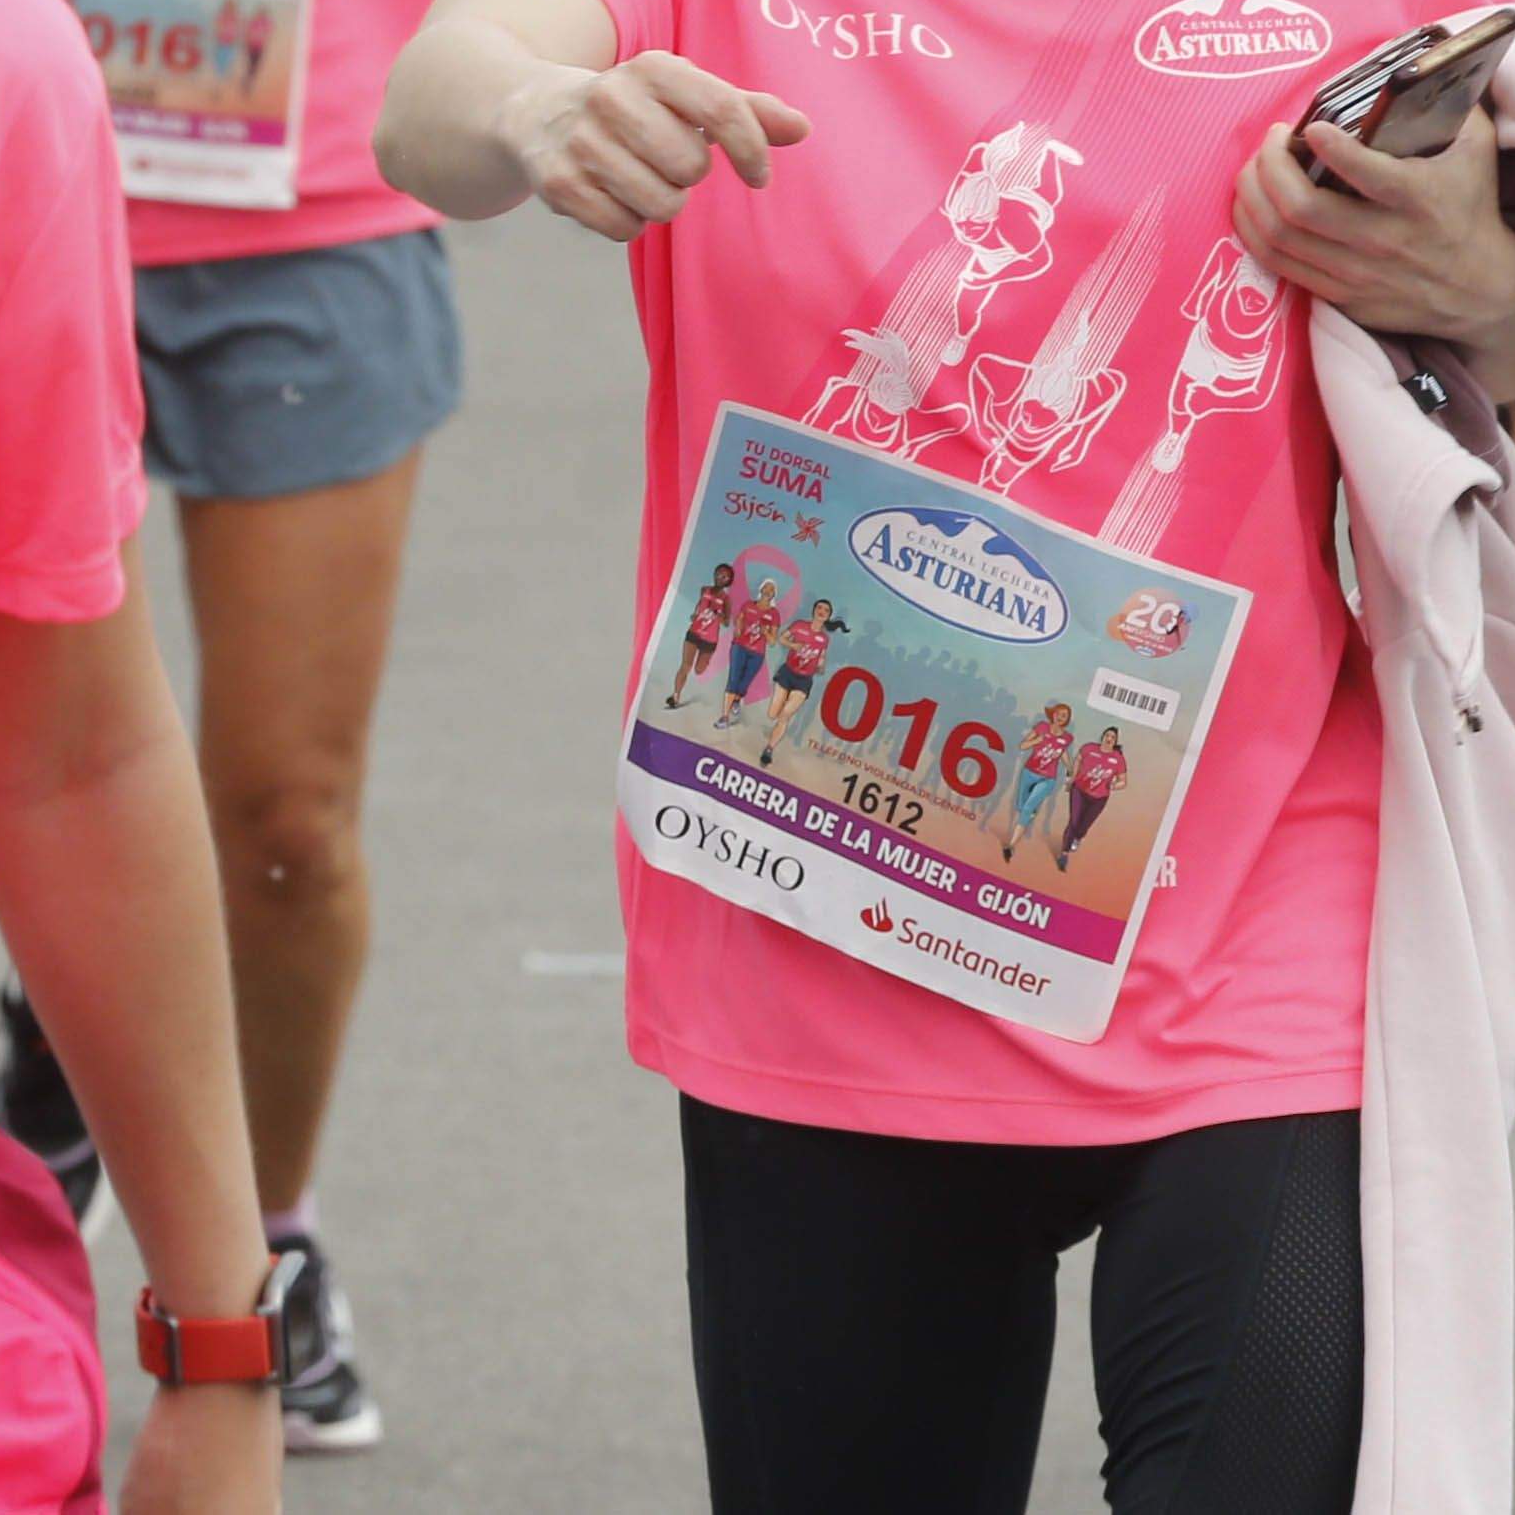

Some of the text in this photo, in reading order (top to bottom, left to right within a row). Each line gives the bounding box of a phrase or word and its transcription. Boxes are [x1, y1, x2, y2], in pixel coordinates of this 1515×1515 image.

[1151, 25, 1320, 63] ASTURIANA
[1180, 16, 1313, 31] CENTRAL LECHERA
[739, 456, 823, 504] SUMA
[745, 439, 831, 480] TU DORSAL
[861, 523, 1047, 634] ASTURIANA
[906, 530, 1051, 601] CENTRAL LECHERA
[1126, 594, 1181, 635] 20
[820, 666, 1006, 798] 016
[842, 773, 924, 835] 1612
[655, 805, 805, 892] OYSHO
[694, 756, 1052, 930] CARRERA DE LA MUJER GIJÓN
[896, 917, 1052, 997] Santander
